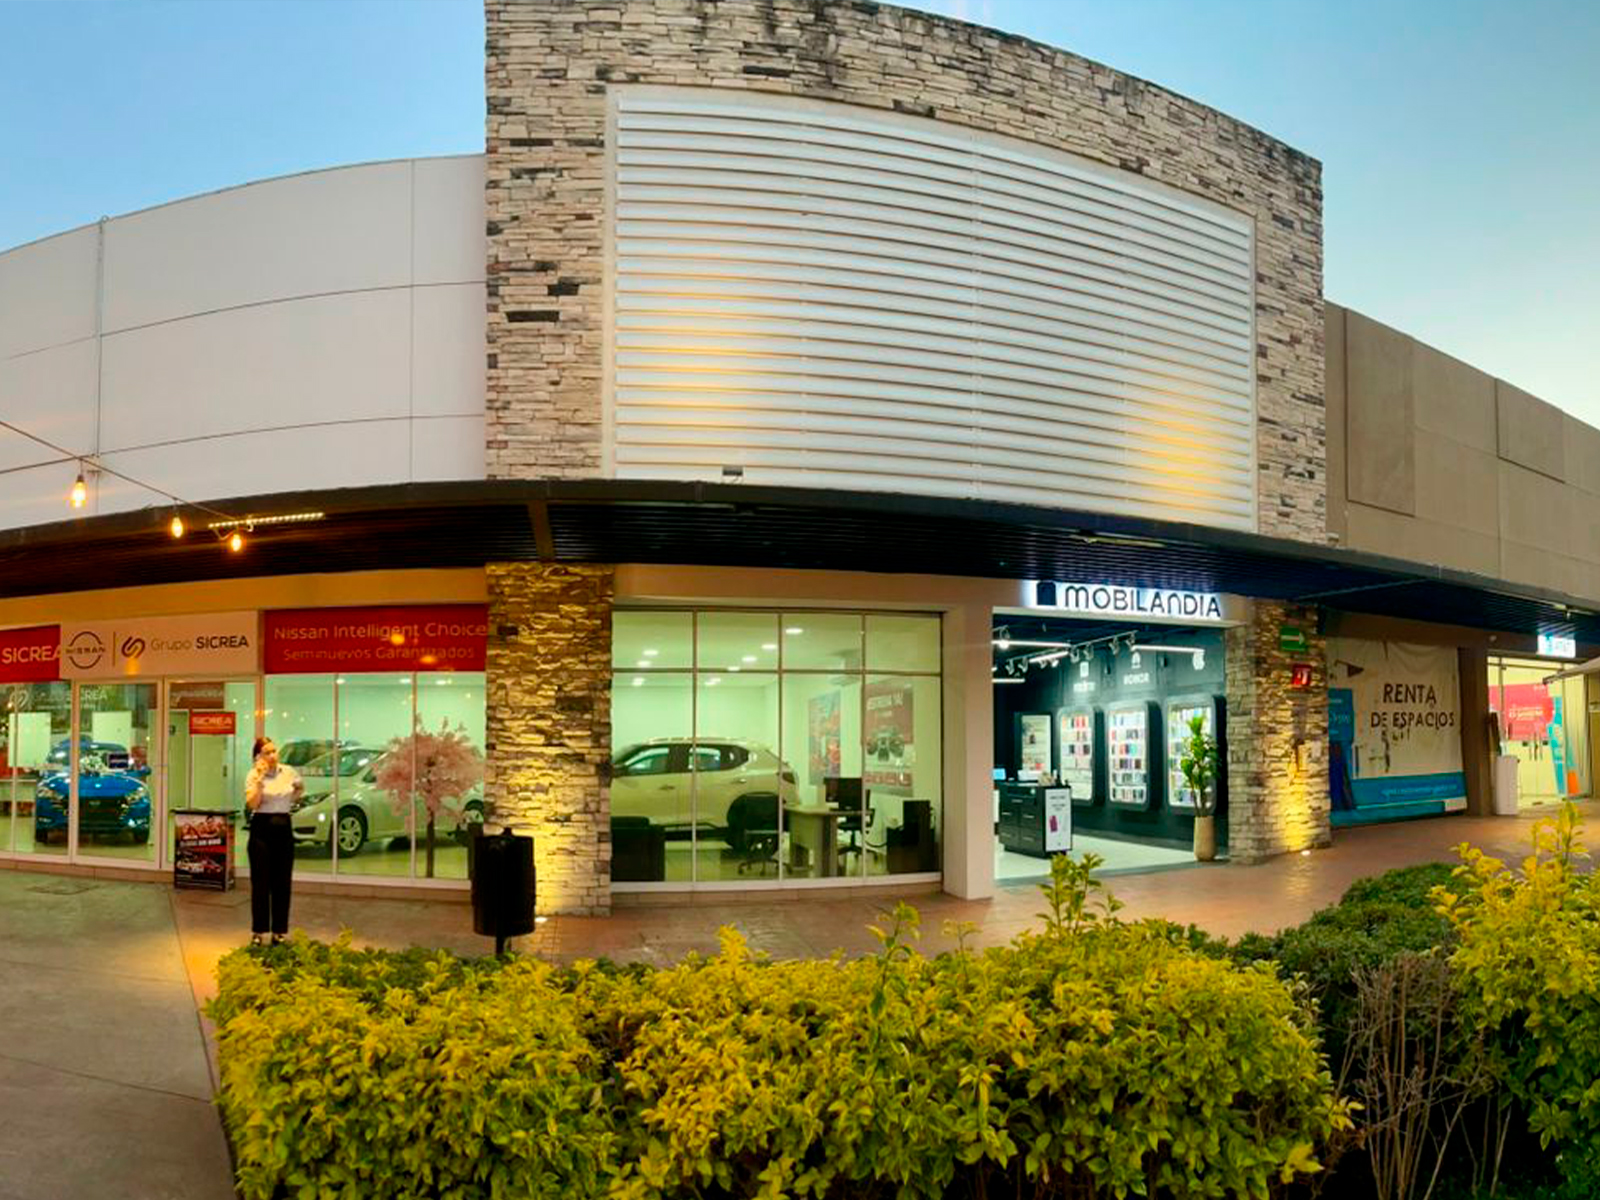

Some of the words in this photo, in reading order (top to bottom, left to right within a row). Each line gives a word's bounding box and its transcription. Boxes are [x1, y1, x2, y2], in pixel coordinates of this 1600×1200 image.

[1065, 585, 1221, 617] MOBILANDIA
[274, 627, 328, 640] Nissan
[334, 624, 420, 641] Intelligent
[424, 622, 487, 637] Choice
[151, 638, 192, 652] Grupo
[196, 635, 249, 650] SICREA
[2, 645, 62, 664] SICREA
[1383, 683, 1437, 704] RENTA
[1371, 711, 1388, 728] DE
[1392, 711, 1455, 730] ESPACIOS
